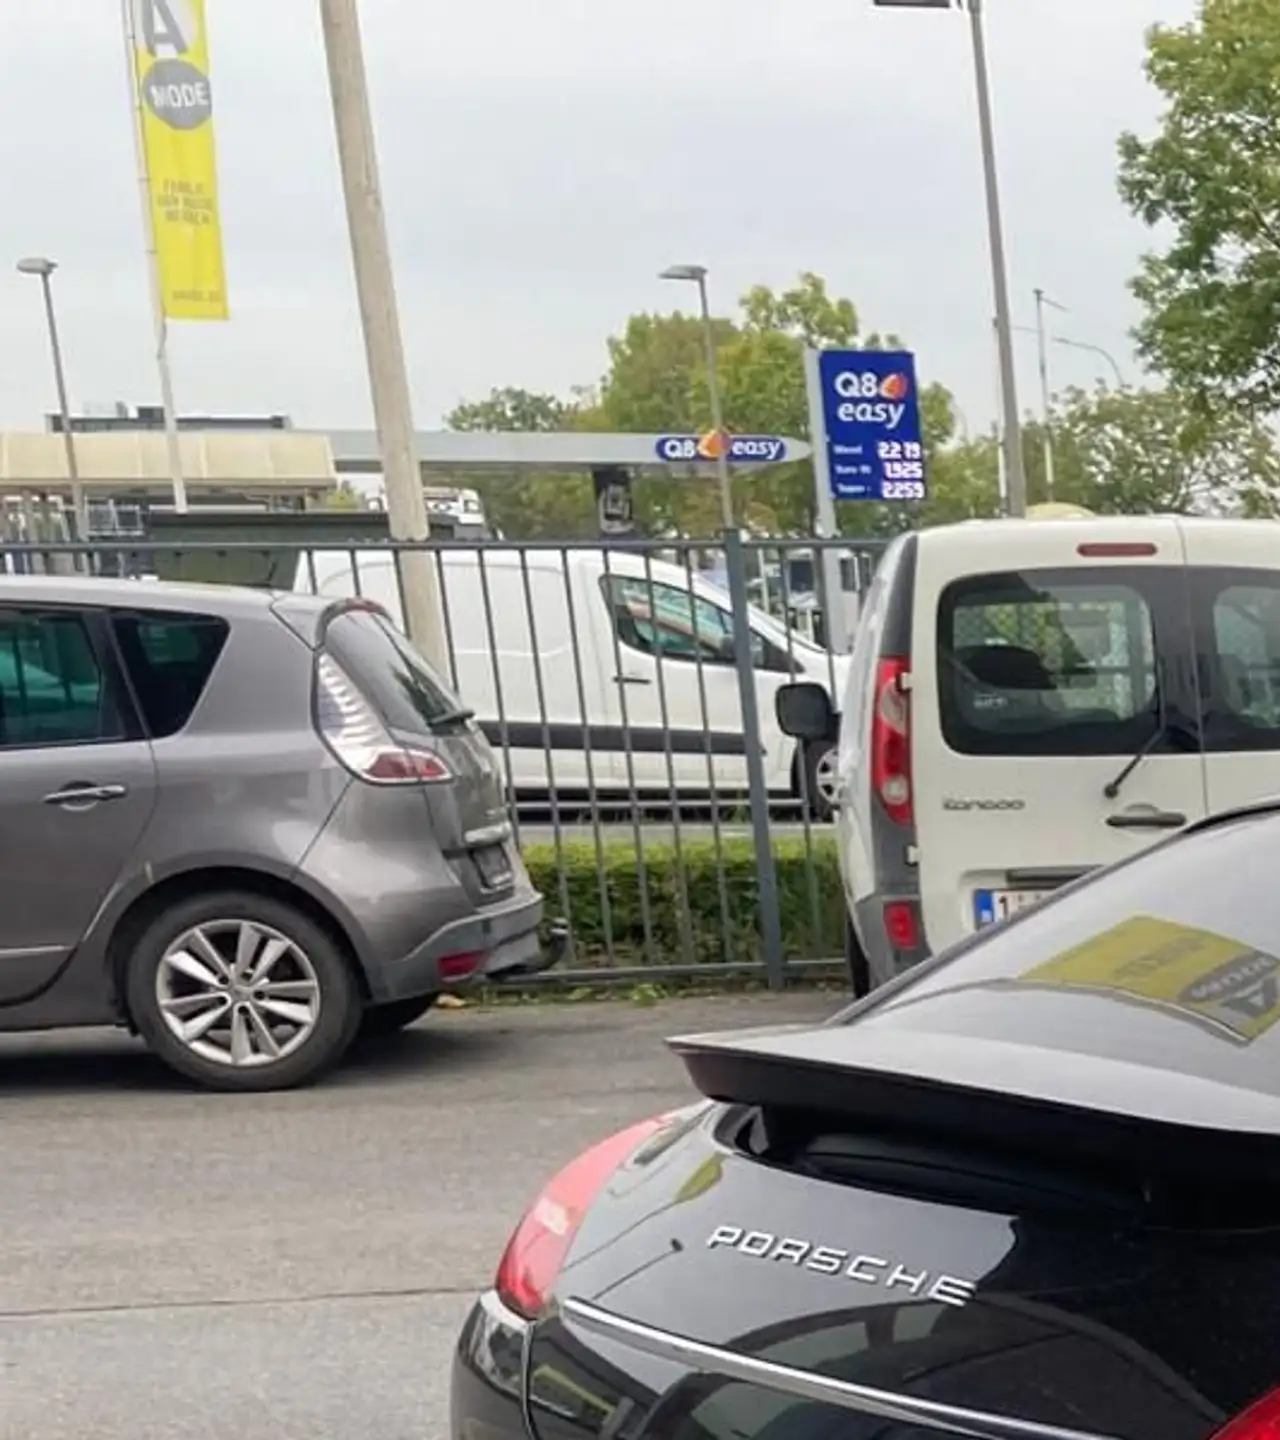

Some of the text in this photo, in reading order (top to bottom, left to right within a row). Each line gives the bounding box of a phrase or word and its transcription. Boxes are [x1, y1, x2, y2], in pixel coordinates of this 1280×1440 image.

[141, 0, 188, 57] A
[149, 81, 209, 107] MODE
[834, 371, 878, 398] Q8
[837, 402, 906, 429] easy
[664, 439, 780, 460] Q8 easy
[706, 1225, 976, 1307] PORSCHE
